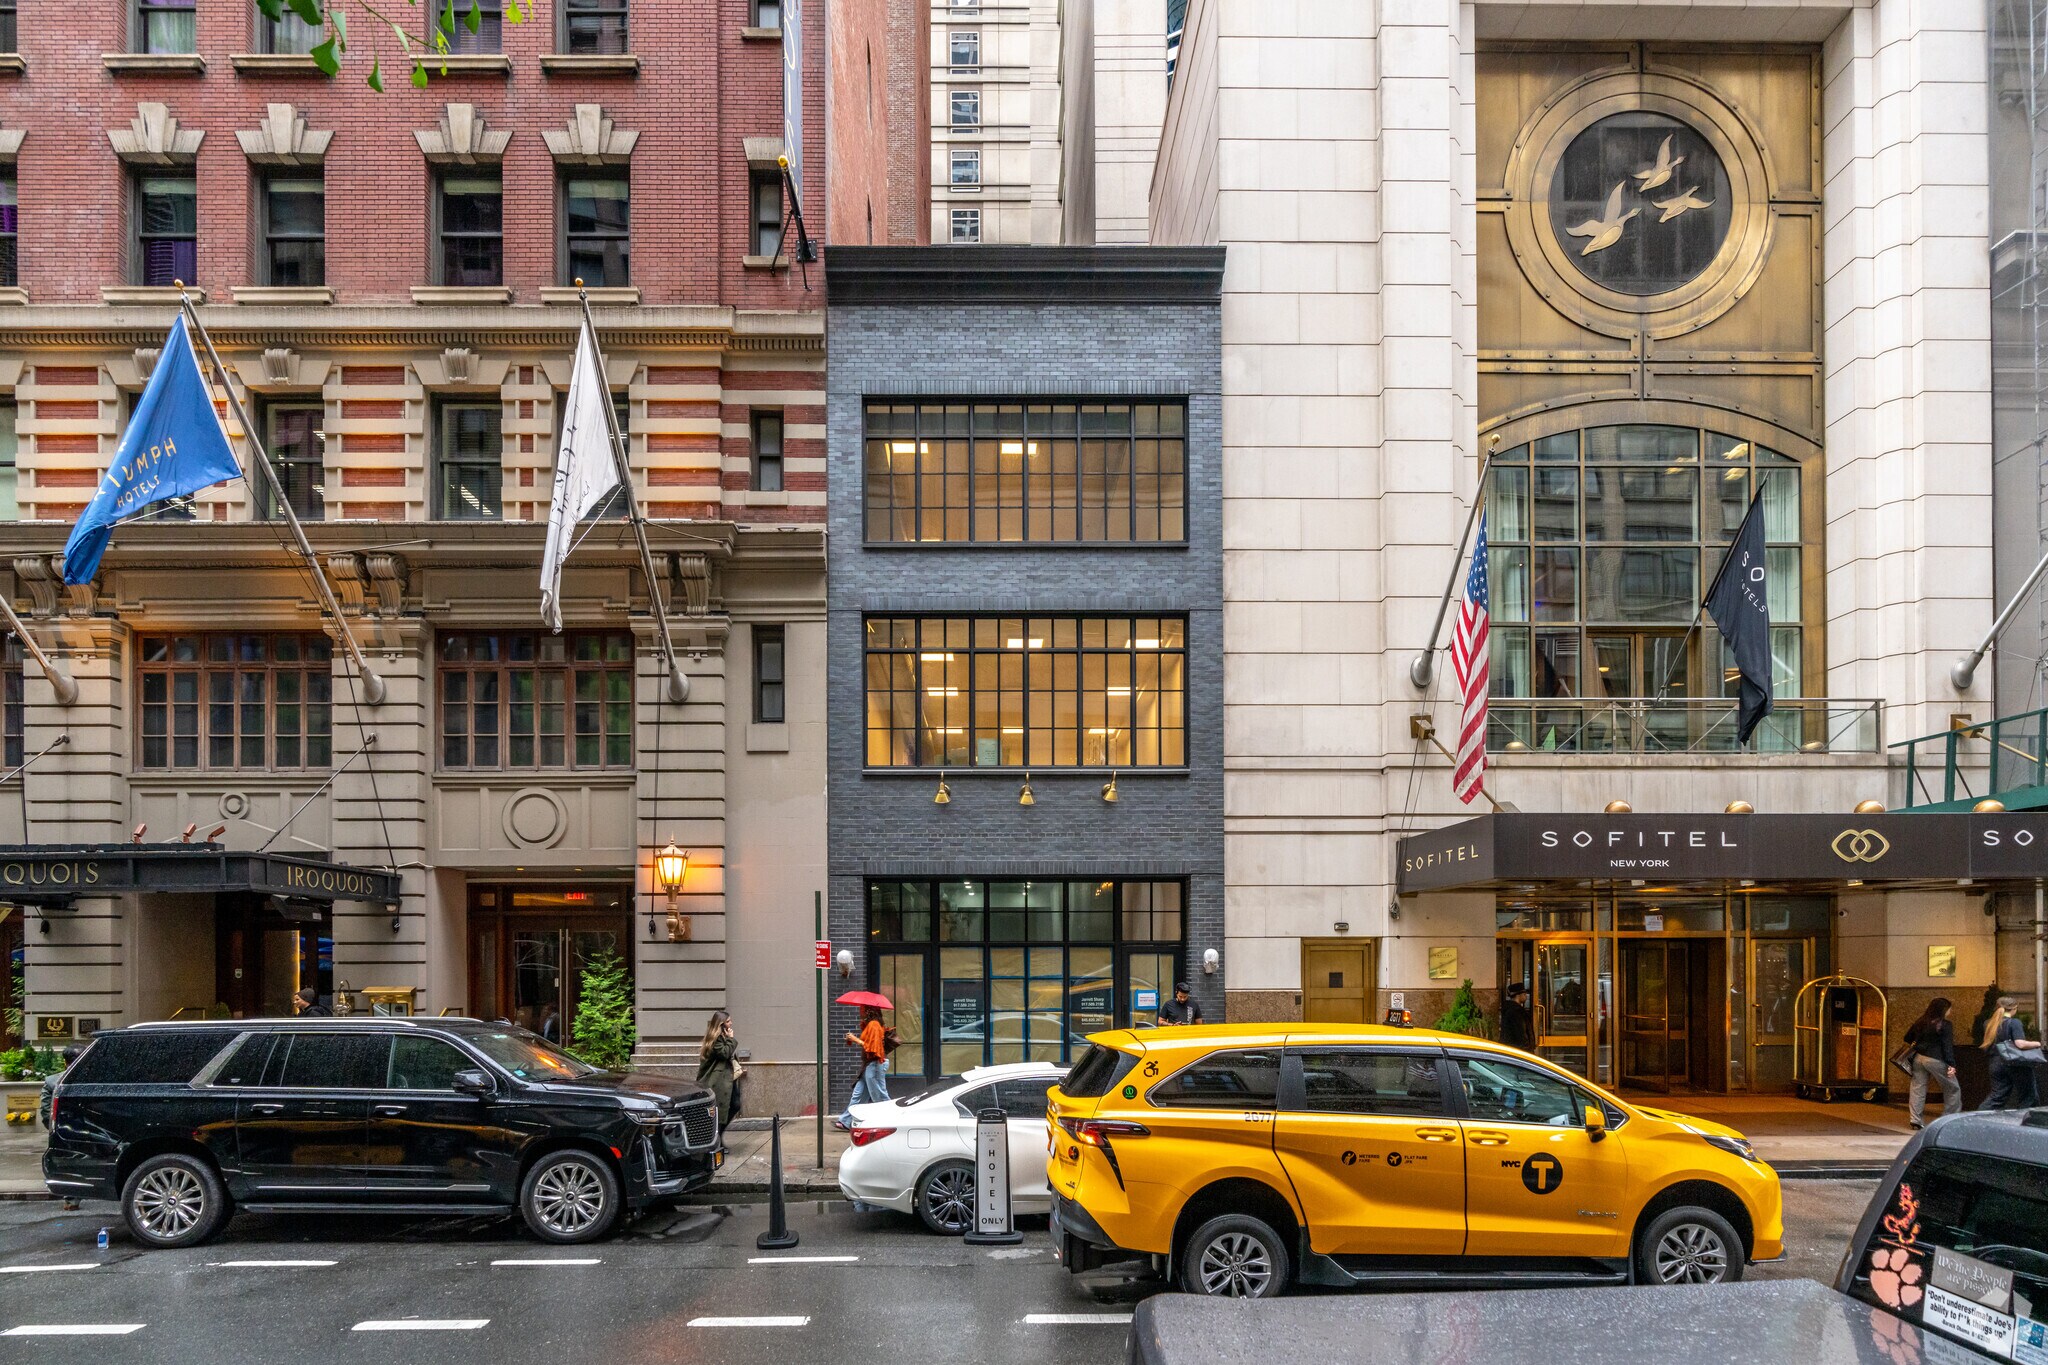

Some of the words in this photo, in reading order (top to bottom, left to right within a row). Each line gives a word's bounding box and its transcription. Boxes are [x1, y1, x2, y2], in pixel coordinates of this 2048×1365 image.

[117, 474, 160, 508] HOTELS
[1541, 830, 1737, 848] SOFITEL
[1405, 844, 1478, 872] SOFITEL
[1610, 859, 1636, 868] NEW
[1639, 859, 1670, 868] YORK
[3, 862, 99, 885] QUOIS
[287, 865, 373, 895] IROQUOIS
[1244, 1112, 1271, 1123] 2G77
[1531, 1160, 1554, 1190] T
[1938, 1255, 1953, 1270] We
[1954, 1258, 1970, 1275] the
[1971, 1265, 2007, 1289] People
[1946, 1273, 1962, 1284] are
[1930, 1303, 1948, 1318] ability
[1972, 1317, 1993, 1334] things
[1946, 1299, 1992, 1322] underestimate
[1994, 1316, 2012, 1330] Joe's
